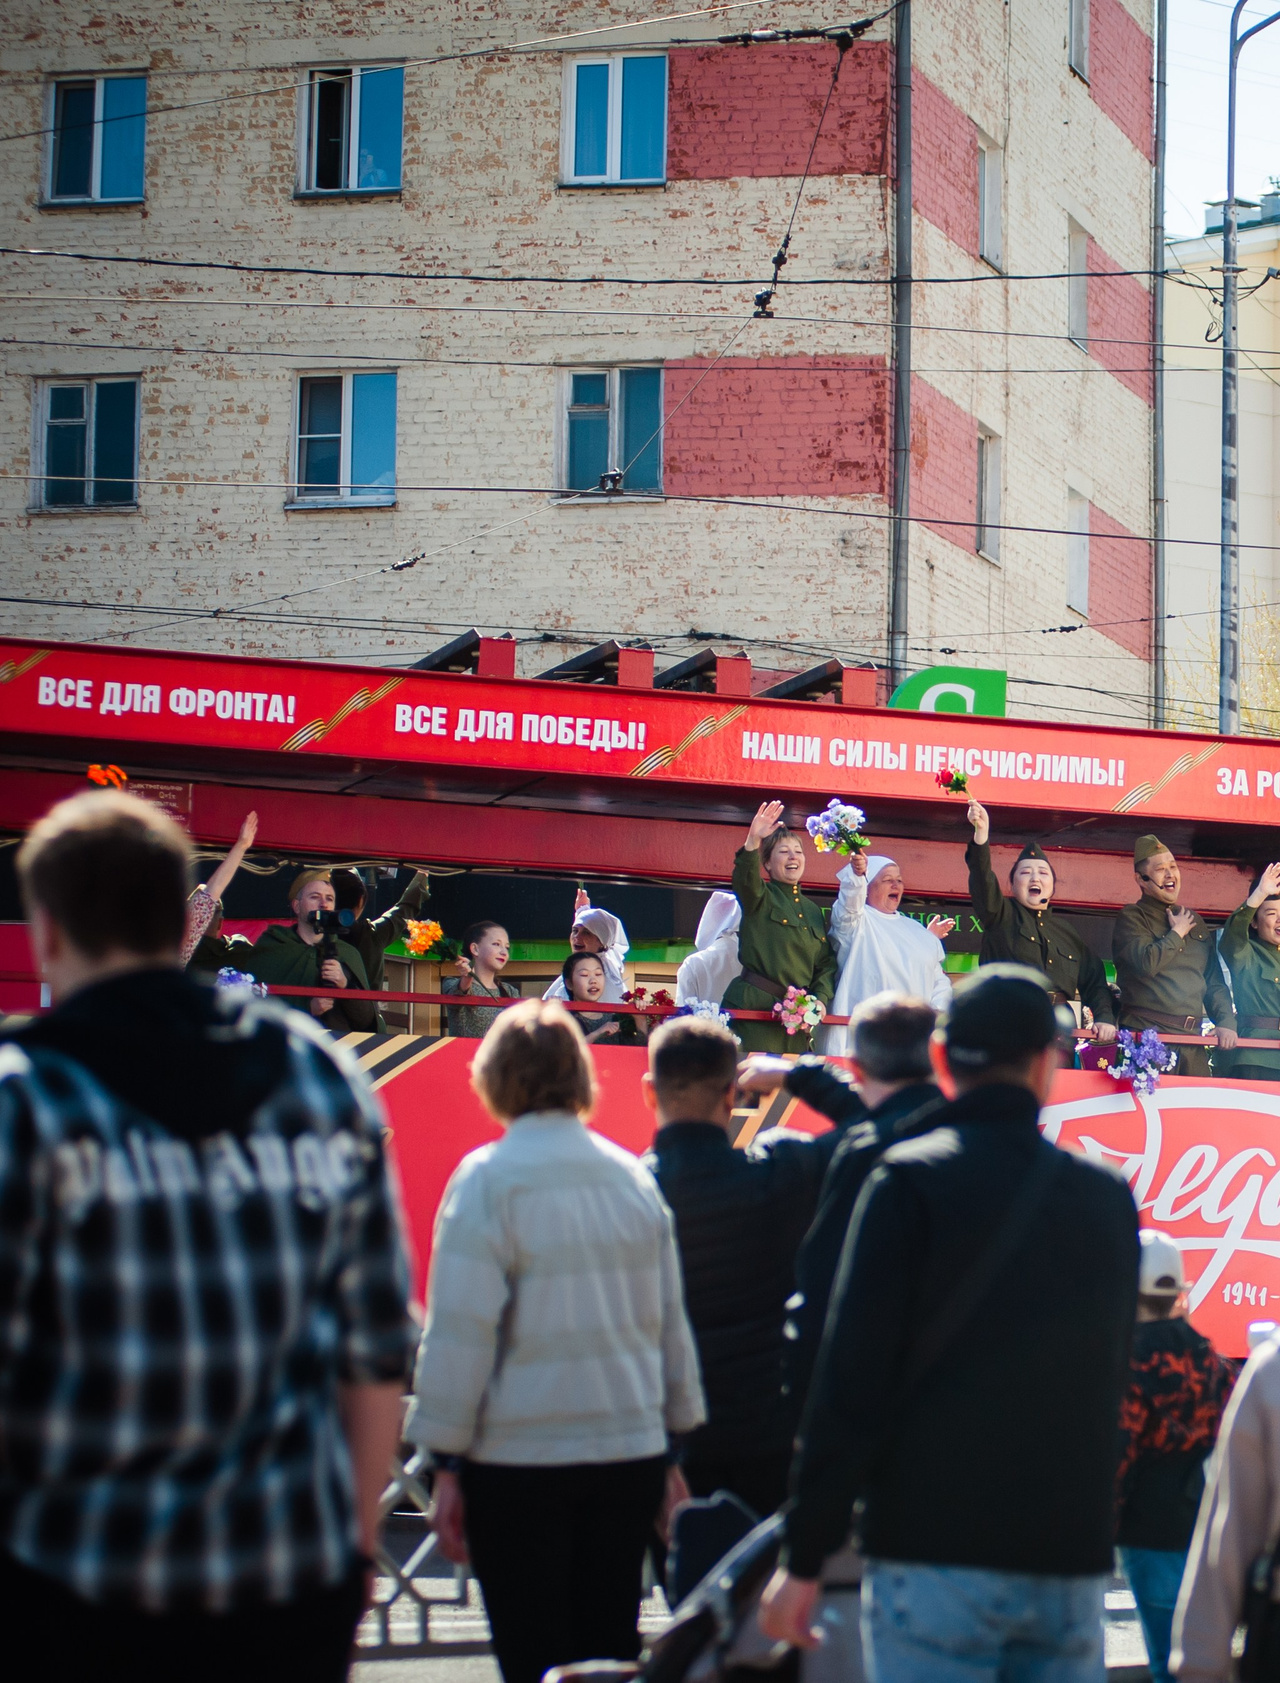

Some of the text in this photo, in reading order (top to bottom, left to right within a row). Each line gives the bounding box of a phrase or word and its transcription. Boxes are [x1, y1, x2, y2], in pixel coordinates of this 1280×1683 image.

[38, 676, 296, 723] ВСЕ ДЛЯ ФРОНТА!
[394, 703, 646, 751] ВСЕ ДЛЯ ПОБЕДЫ!
[741, 730, 1126, 788] НАШИ СИЛЫ НЕИСЧИСЛИМЫ!
[1215, 766, 1251, 798] ЗА
